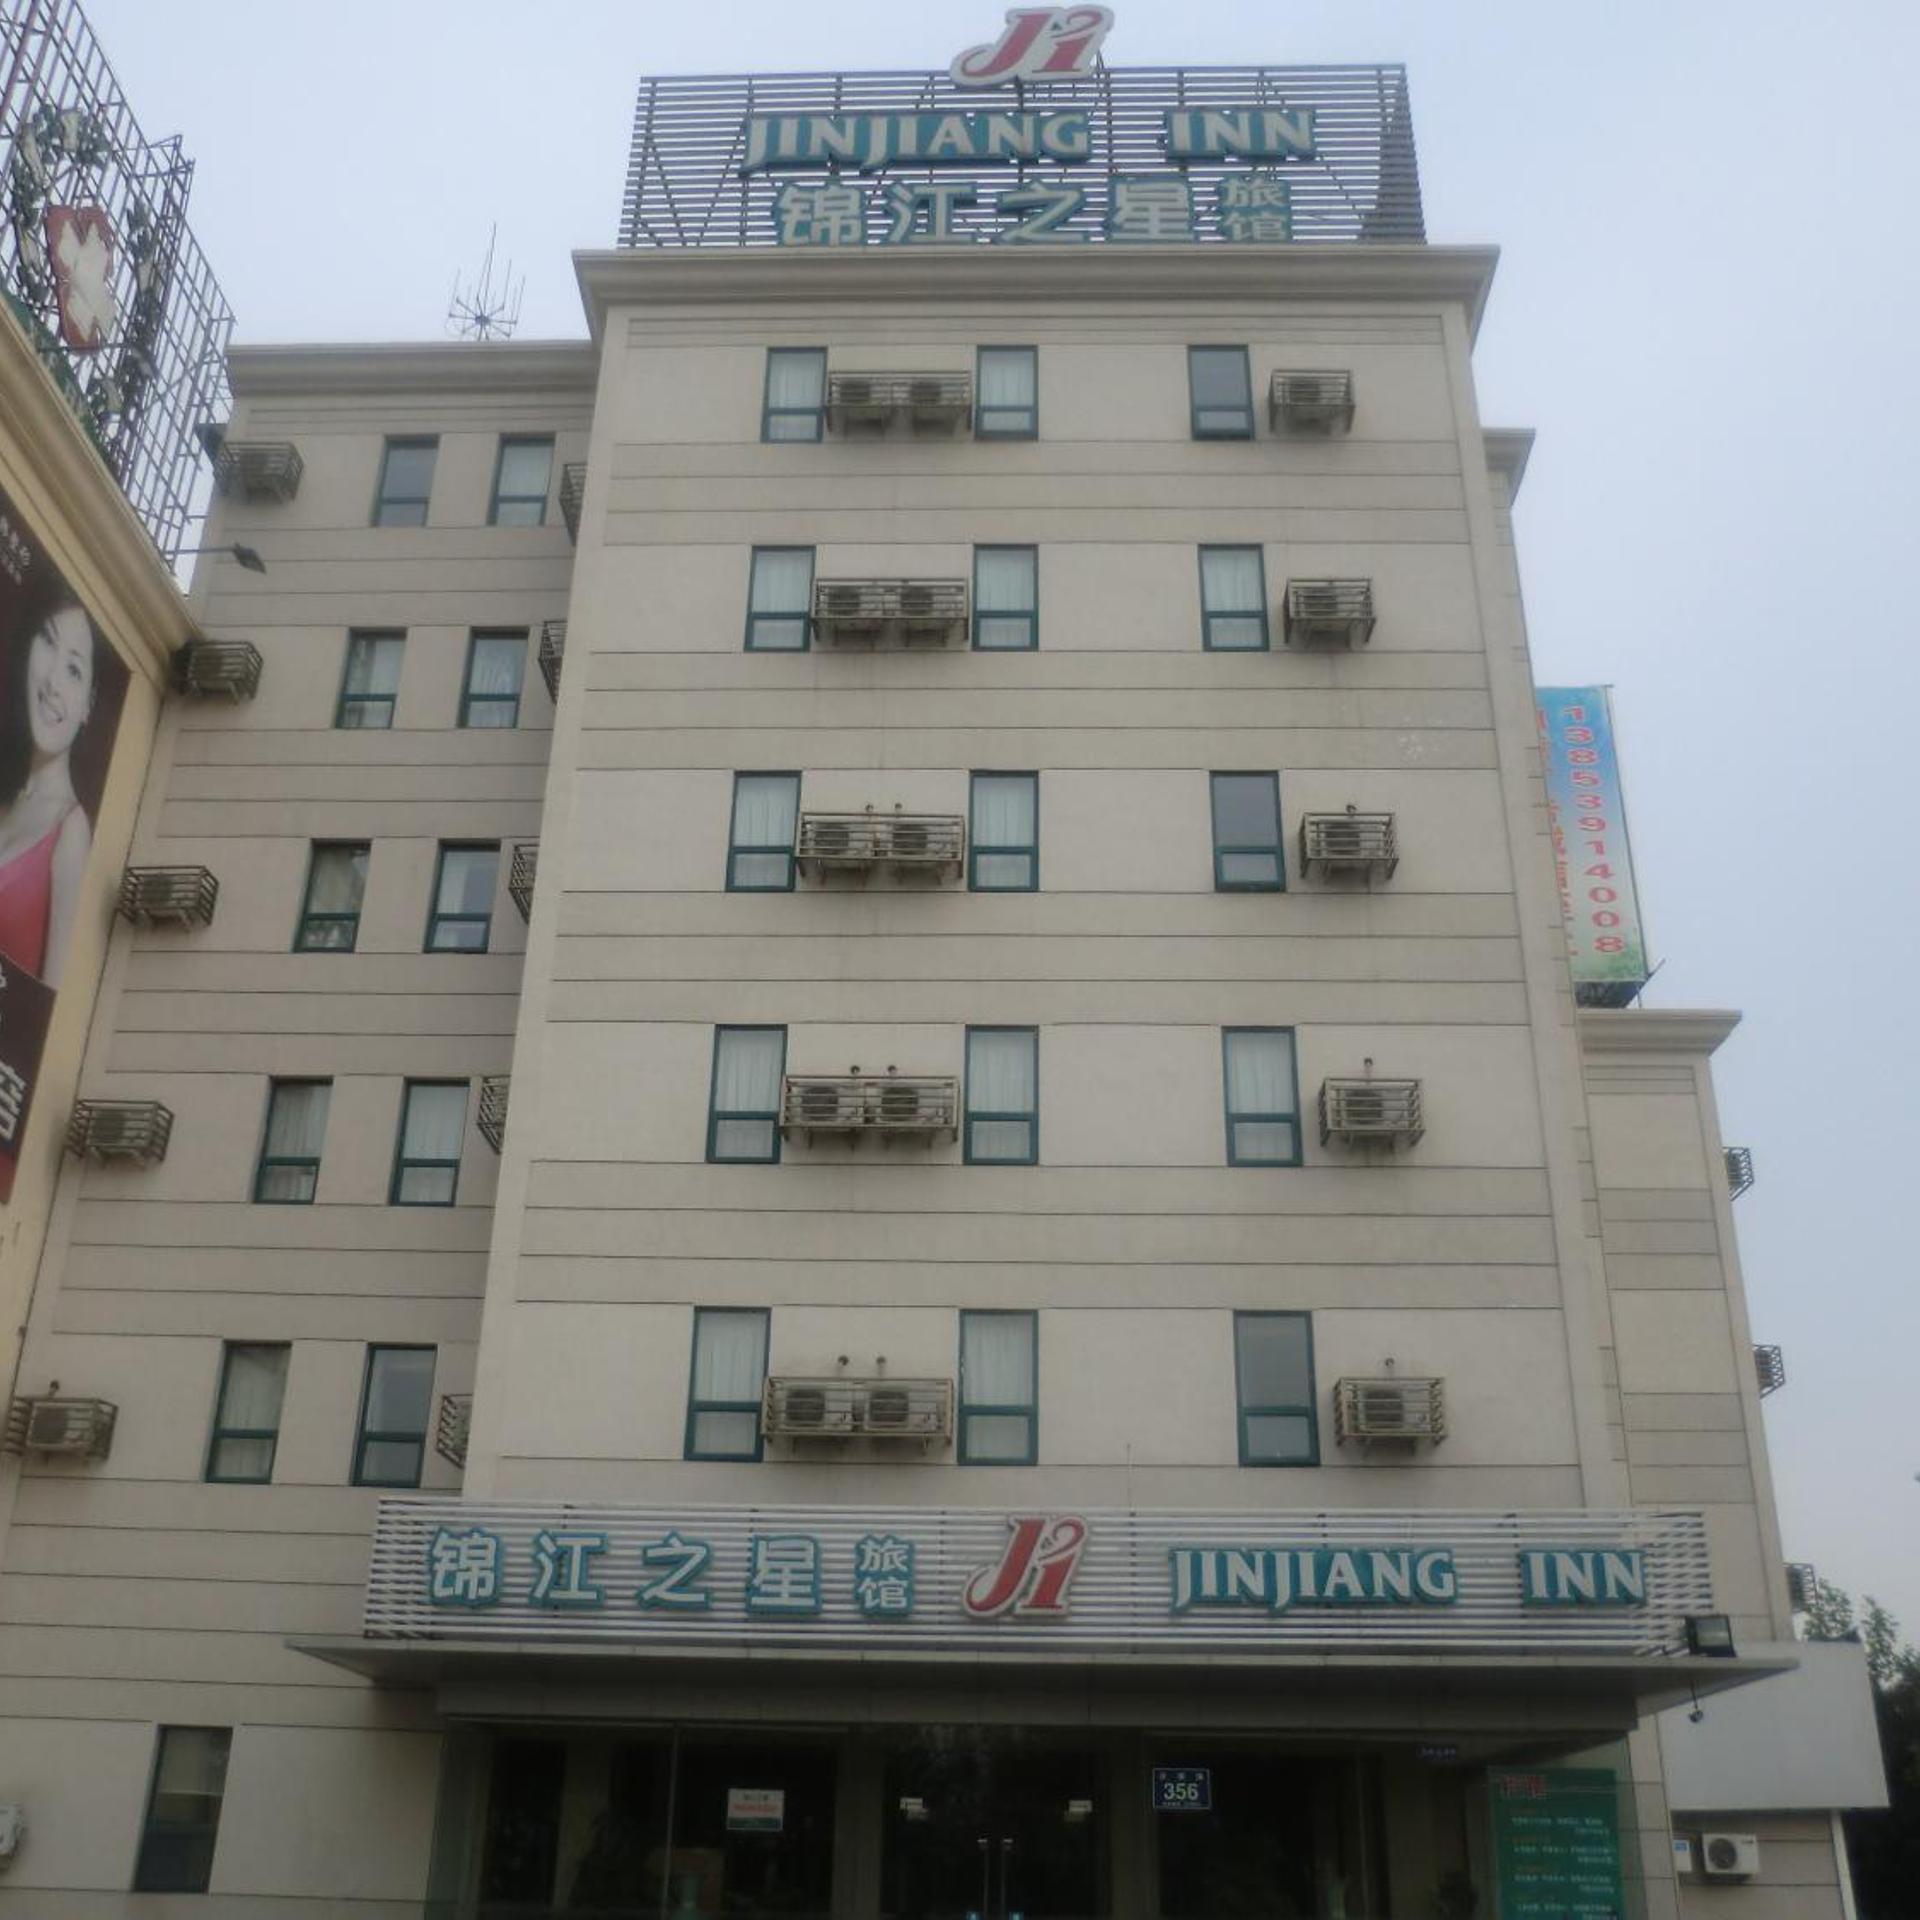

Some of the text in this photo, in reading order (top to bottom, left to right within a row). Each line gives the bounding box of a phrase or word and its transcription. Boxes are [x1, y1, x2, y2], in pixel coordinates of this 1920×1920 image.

[743, 110, 1312, 168] JINJIANG INN
[1173, 1550, 1645, 1608] JINJIANG INN
[1162, 1781, 1200, 1801] 356
